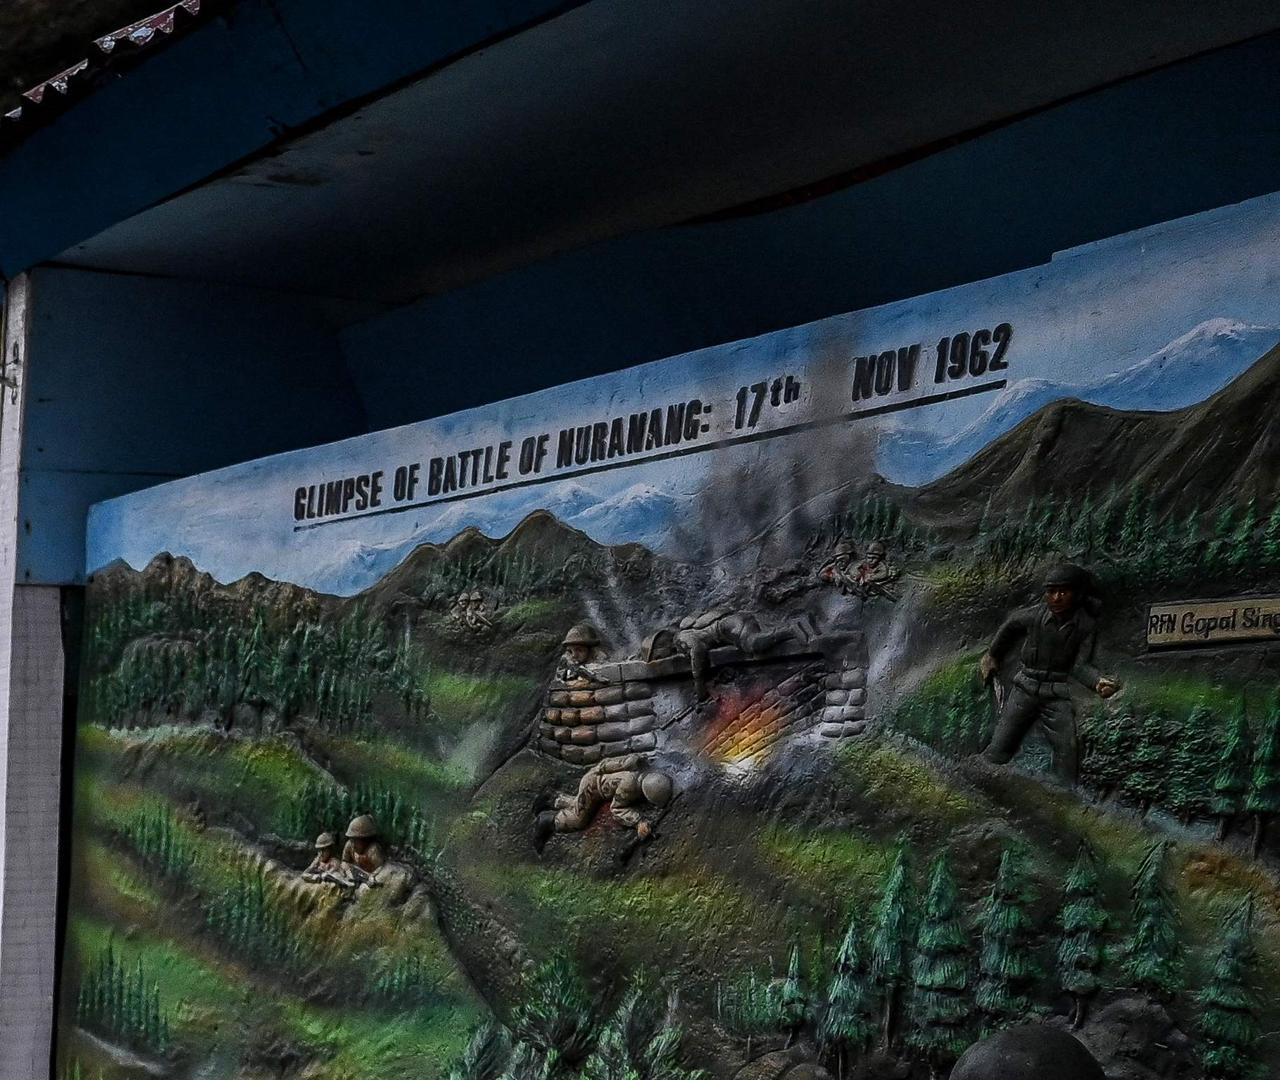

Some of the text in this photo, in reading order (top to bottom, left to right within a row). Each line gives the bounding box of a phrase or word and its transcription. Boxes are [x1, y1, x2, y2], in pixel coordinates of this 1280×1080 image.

[295, 322, 1013, 520] GLIMPSE OF BATTLE OF NURANANG: 17th NOV 1962
[1148, 613, 1176, 635] RFN
[1181, 609, 1237, 638] Gopal
